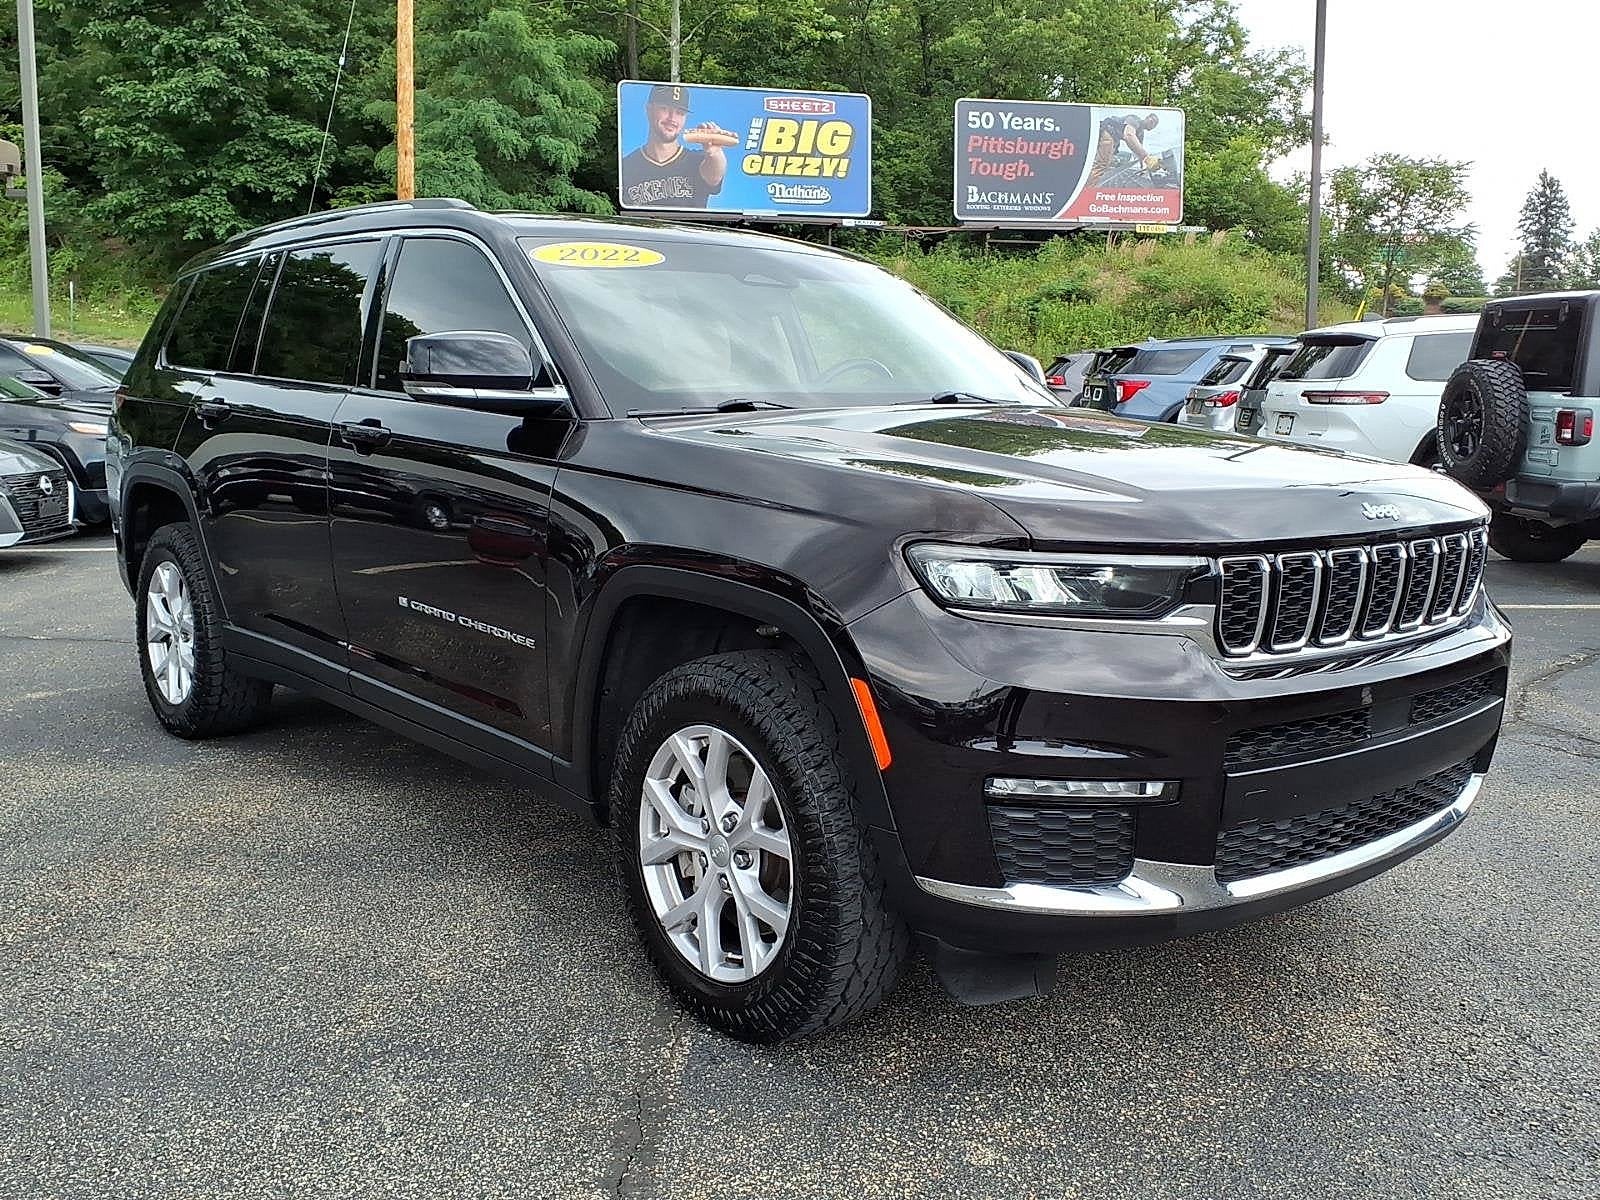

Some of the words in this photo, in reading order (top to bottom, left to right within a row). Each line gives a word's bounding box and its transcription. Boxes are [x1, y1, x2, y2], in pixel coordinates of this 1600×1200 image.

[768, 99, 831, 113] SHEETZ
[967, 111, 995, 129] 50
[998, 111, 1061, 132] Years.
[744, 117, 764, 151] THE
[761, 117, 854, 157] BIG
[967, 135, 1075, 160] Pittsburgh
[742, 153, 851, 179] GLIZZY!
[968, 157, 1035, 181] Tough.
[767, 182, 831, 200] Nathan's
[1095, 191, 1116, 202] Free
[1117, 192, 1165, 204] Inspection
[1088, 203, 1171, 215] GoBachmans.com
[559, 247, 641, 263] 2022
[1361, 501, 1400, 521] Jeep
[410, 600, 456, 623] GRAND
[457, 615, 536, 650] CHEROKEE
